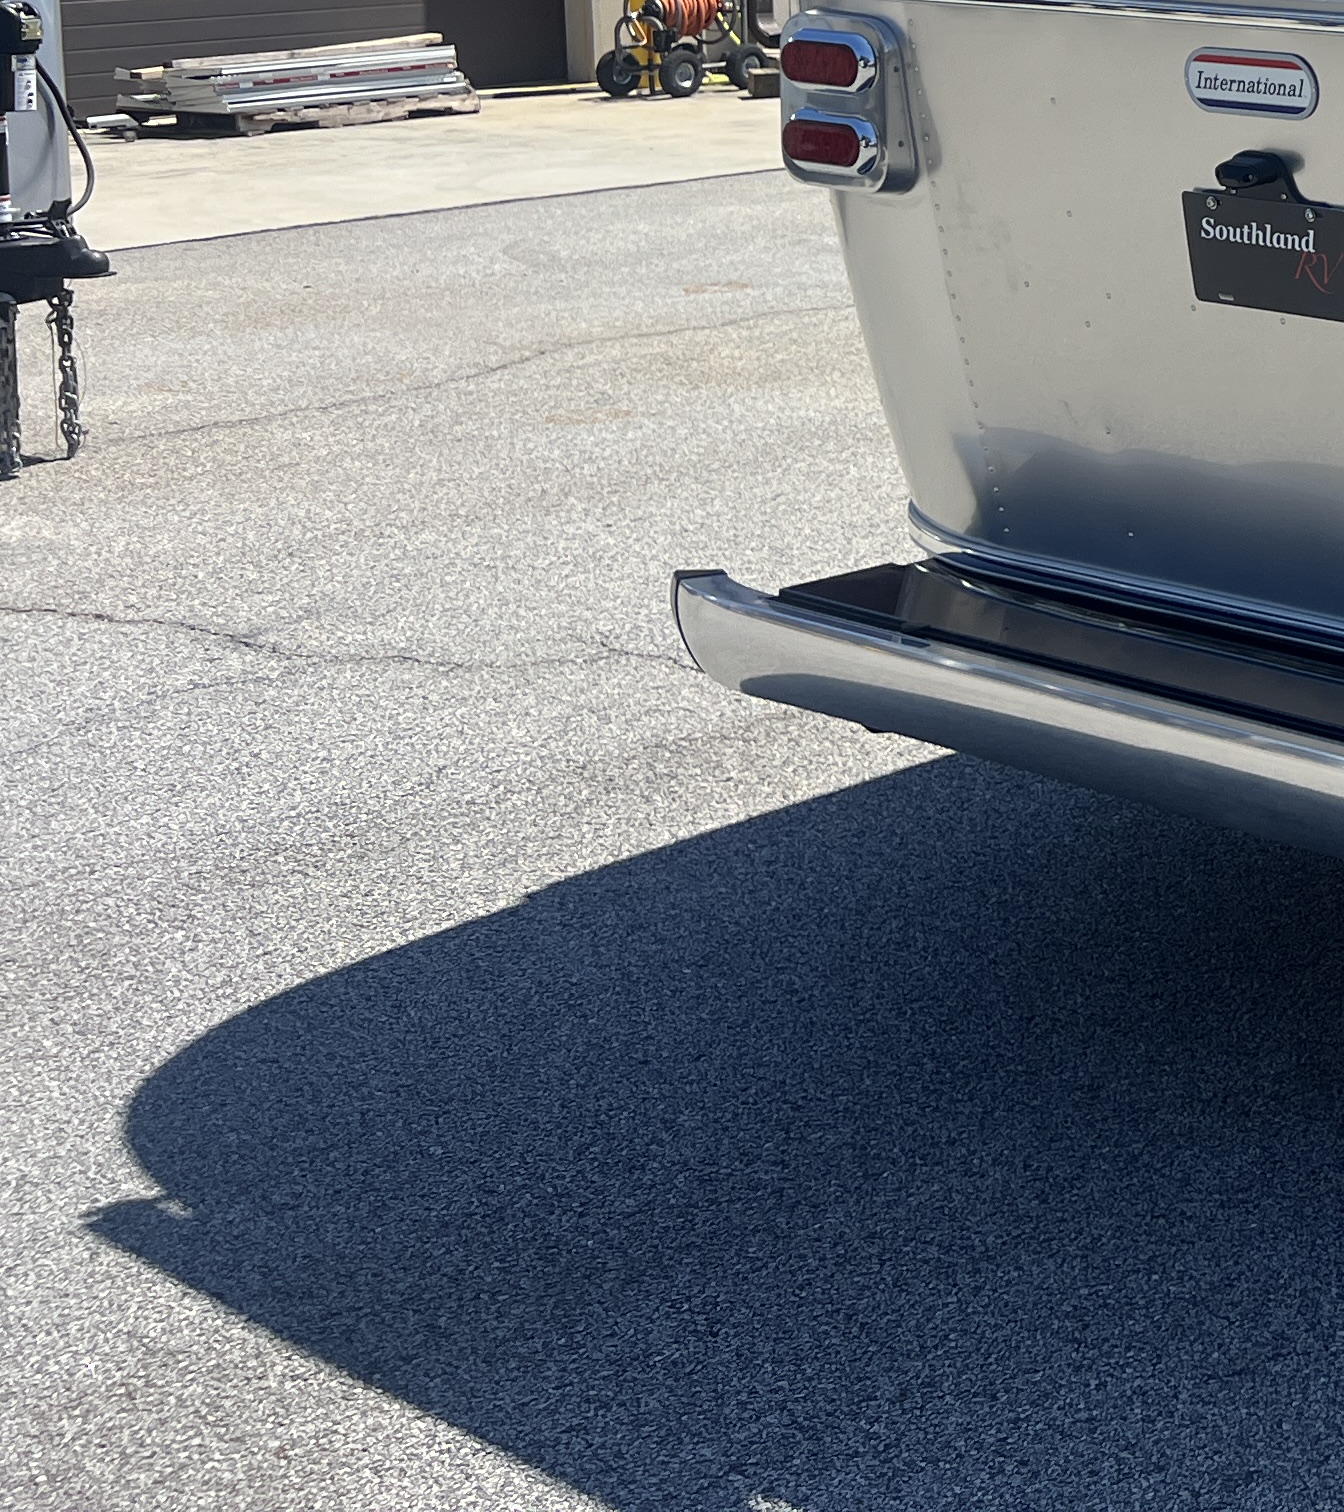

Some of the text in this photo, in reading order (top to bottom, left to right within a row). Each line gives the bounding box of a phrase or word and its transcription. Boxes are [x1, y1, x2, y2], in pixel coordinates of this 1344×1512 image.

[1195, 70, 1304, 98] International
[1200, 216, 1316, 253] Southland
[1295, 250, 1344, 295] RV
